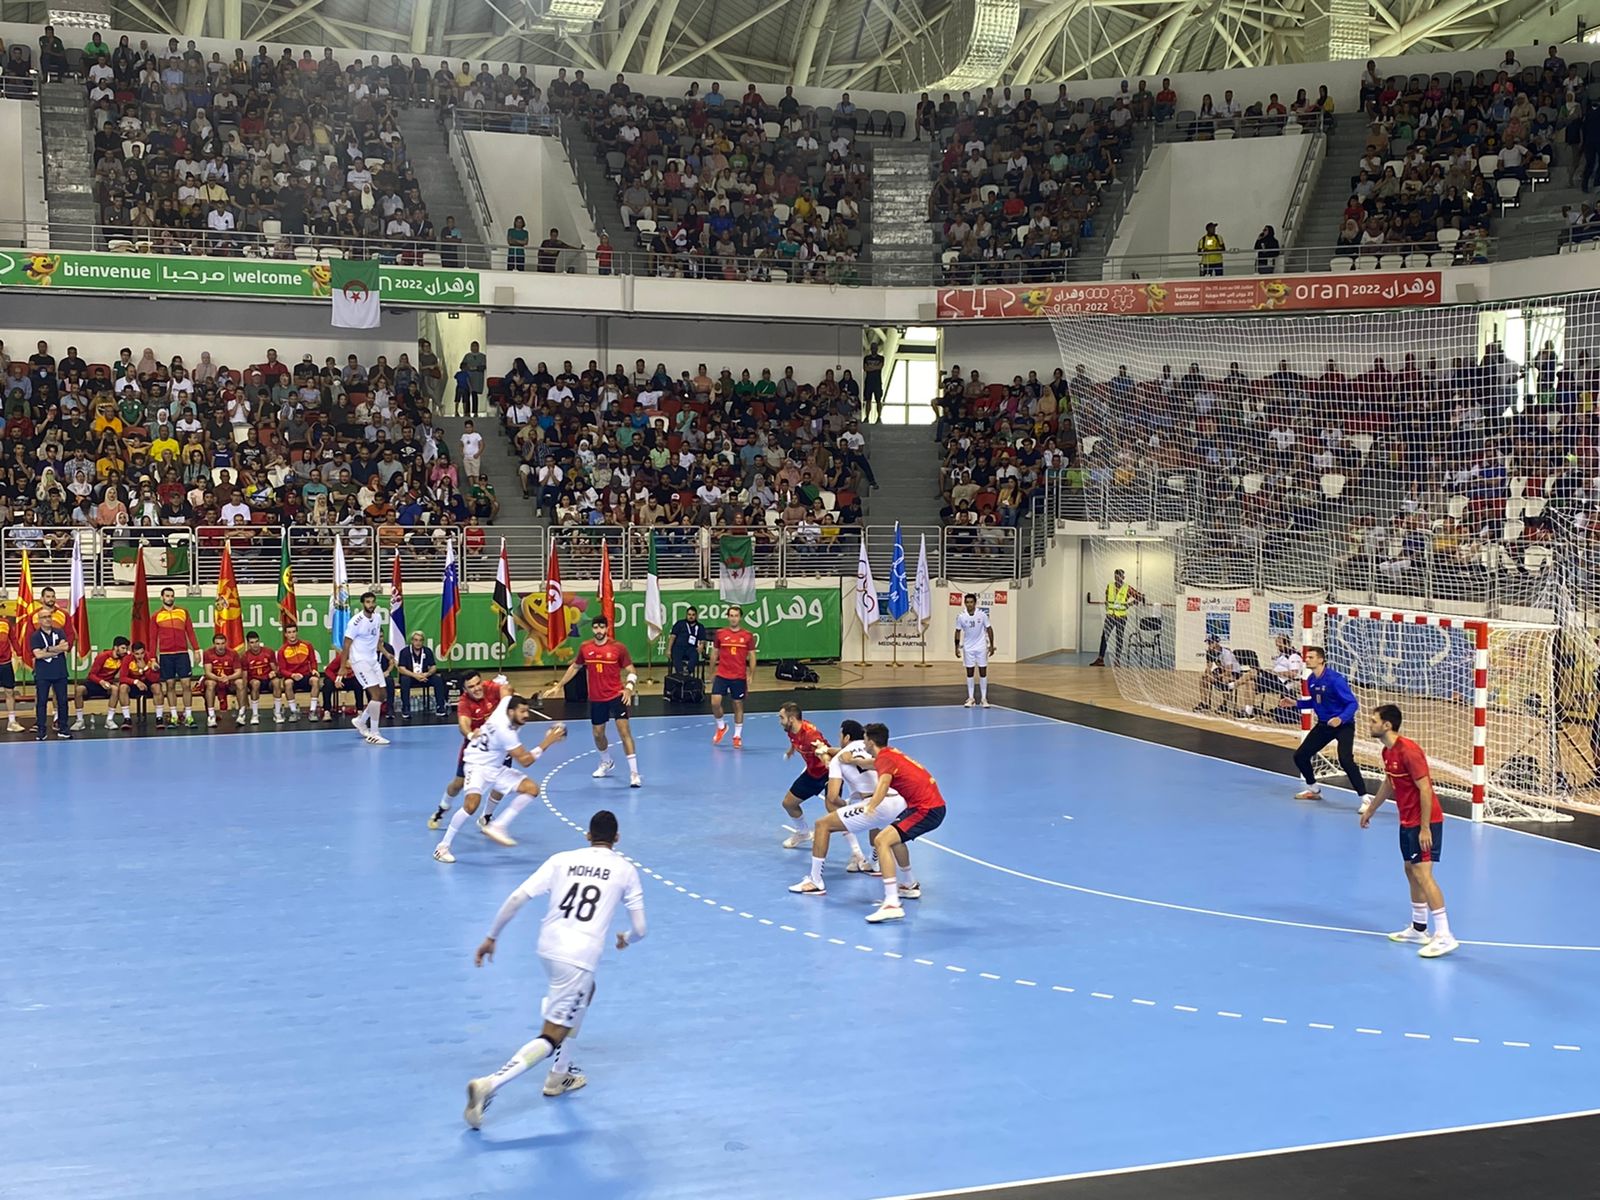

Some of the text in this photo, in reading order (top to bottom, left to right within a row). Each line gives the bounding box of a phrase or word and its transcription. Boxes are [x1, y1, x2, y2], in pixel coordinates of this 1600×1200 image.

[64, 262, 151, 279] bienvenue
[163, 266, 225, 284] مرحبا
[233, 269, 302, 285] welcome
[395, 278, 422, 290] 2022
[424, 277, 475, 297] وهران
[1295, 283, 1381, 300] oran 2022
[1382, 277, 1436, 299] وهران
[1053, 302, 1109, 313] oran 2022
[698, 604, 741, 619] 202
[744, 595, 823, 628] وهران
[427, 638, 506, 662] lcome
[567, 865, 611, 880] MOHAB
[558, 882, 602, 922] 48
